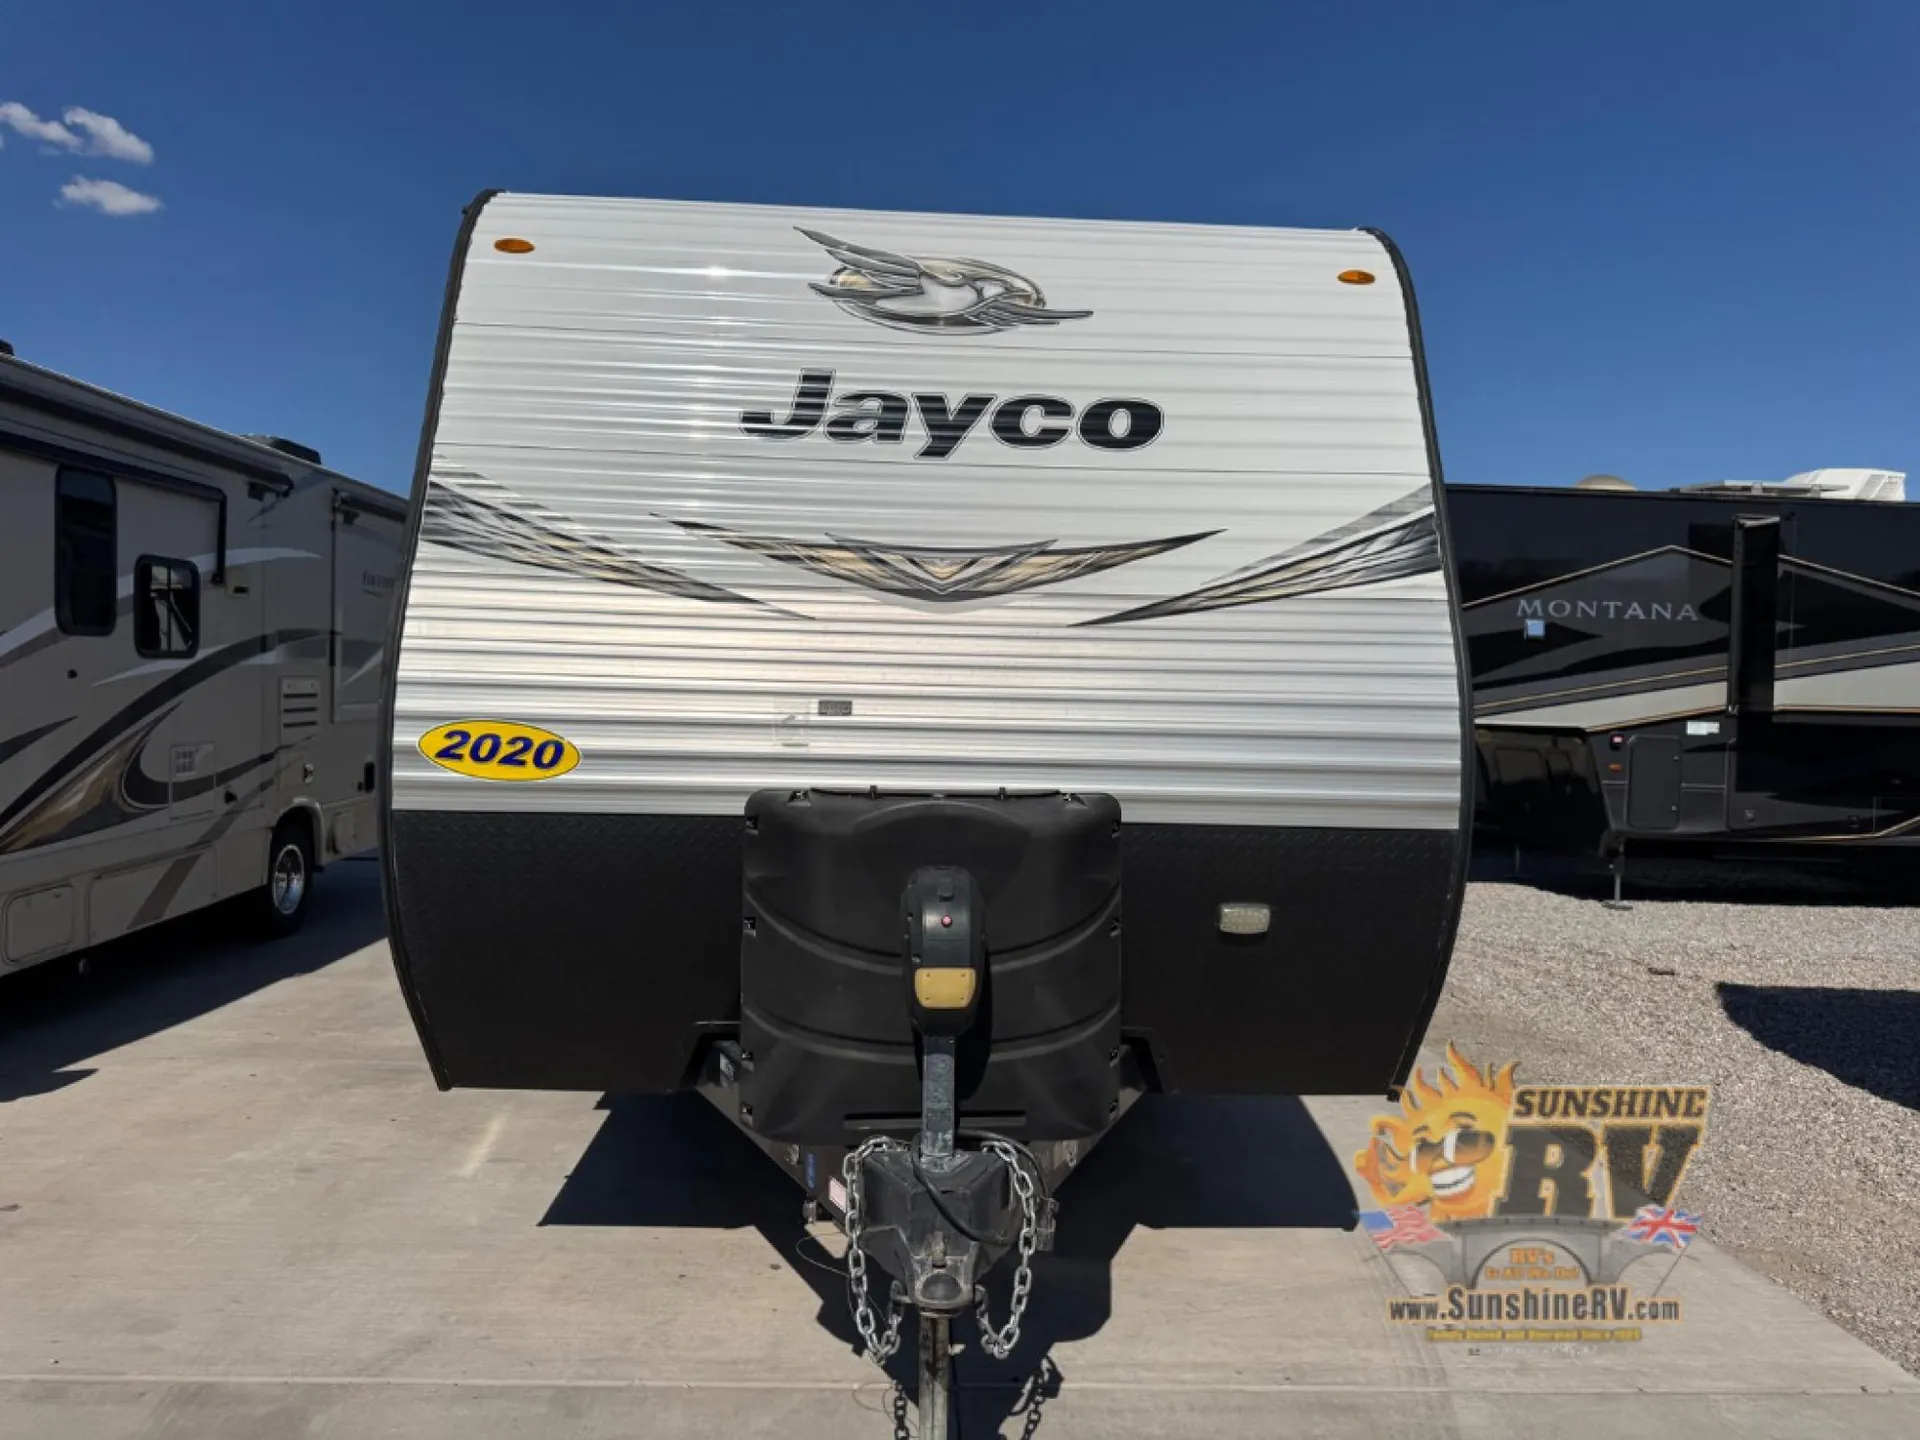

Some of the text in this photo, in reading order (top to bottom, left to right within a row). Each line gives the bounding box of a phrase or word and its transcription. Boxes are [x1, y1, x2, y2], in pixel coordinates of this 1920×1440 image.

[739, 367, 1164, 461] Jayco
[1516, 599, 1699, 621] MONTANA
[434, 729, 566, 770] 2020
